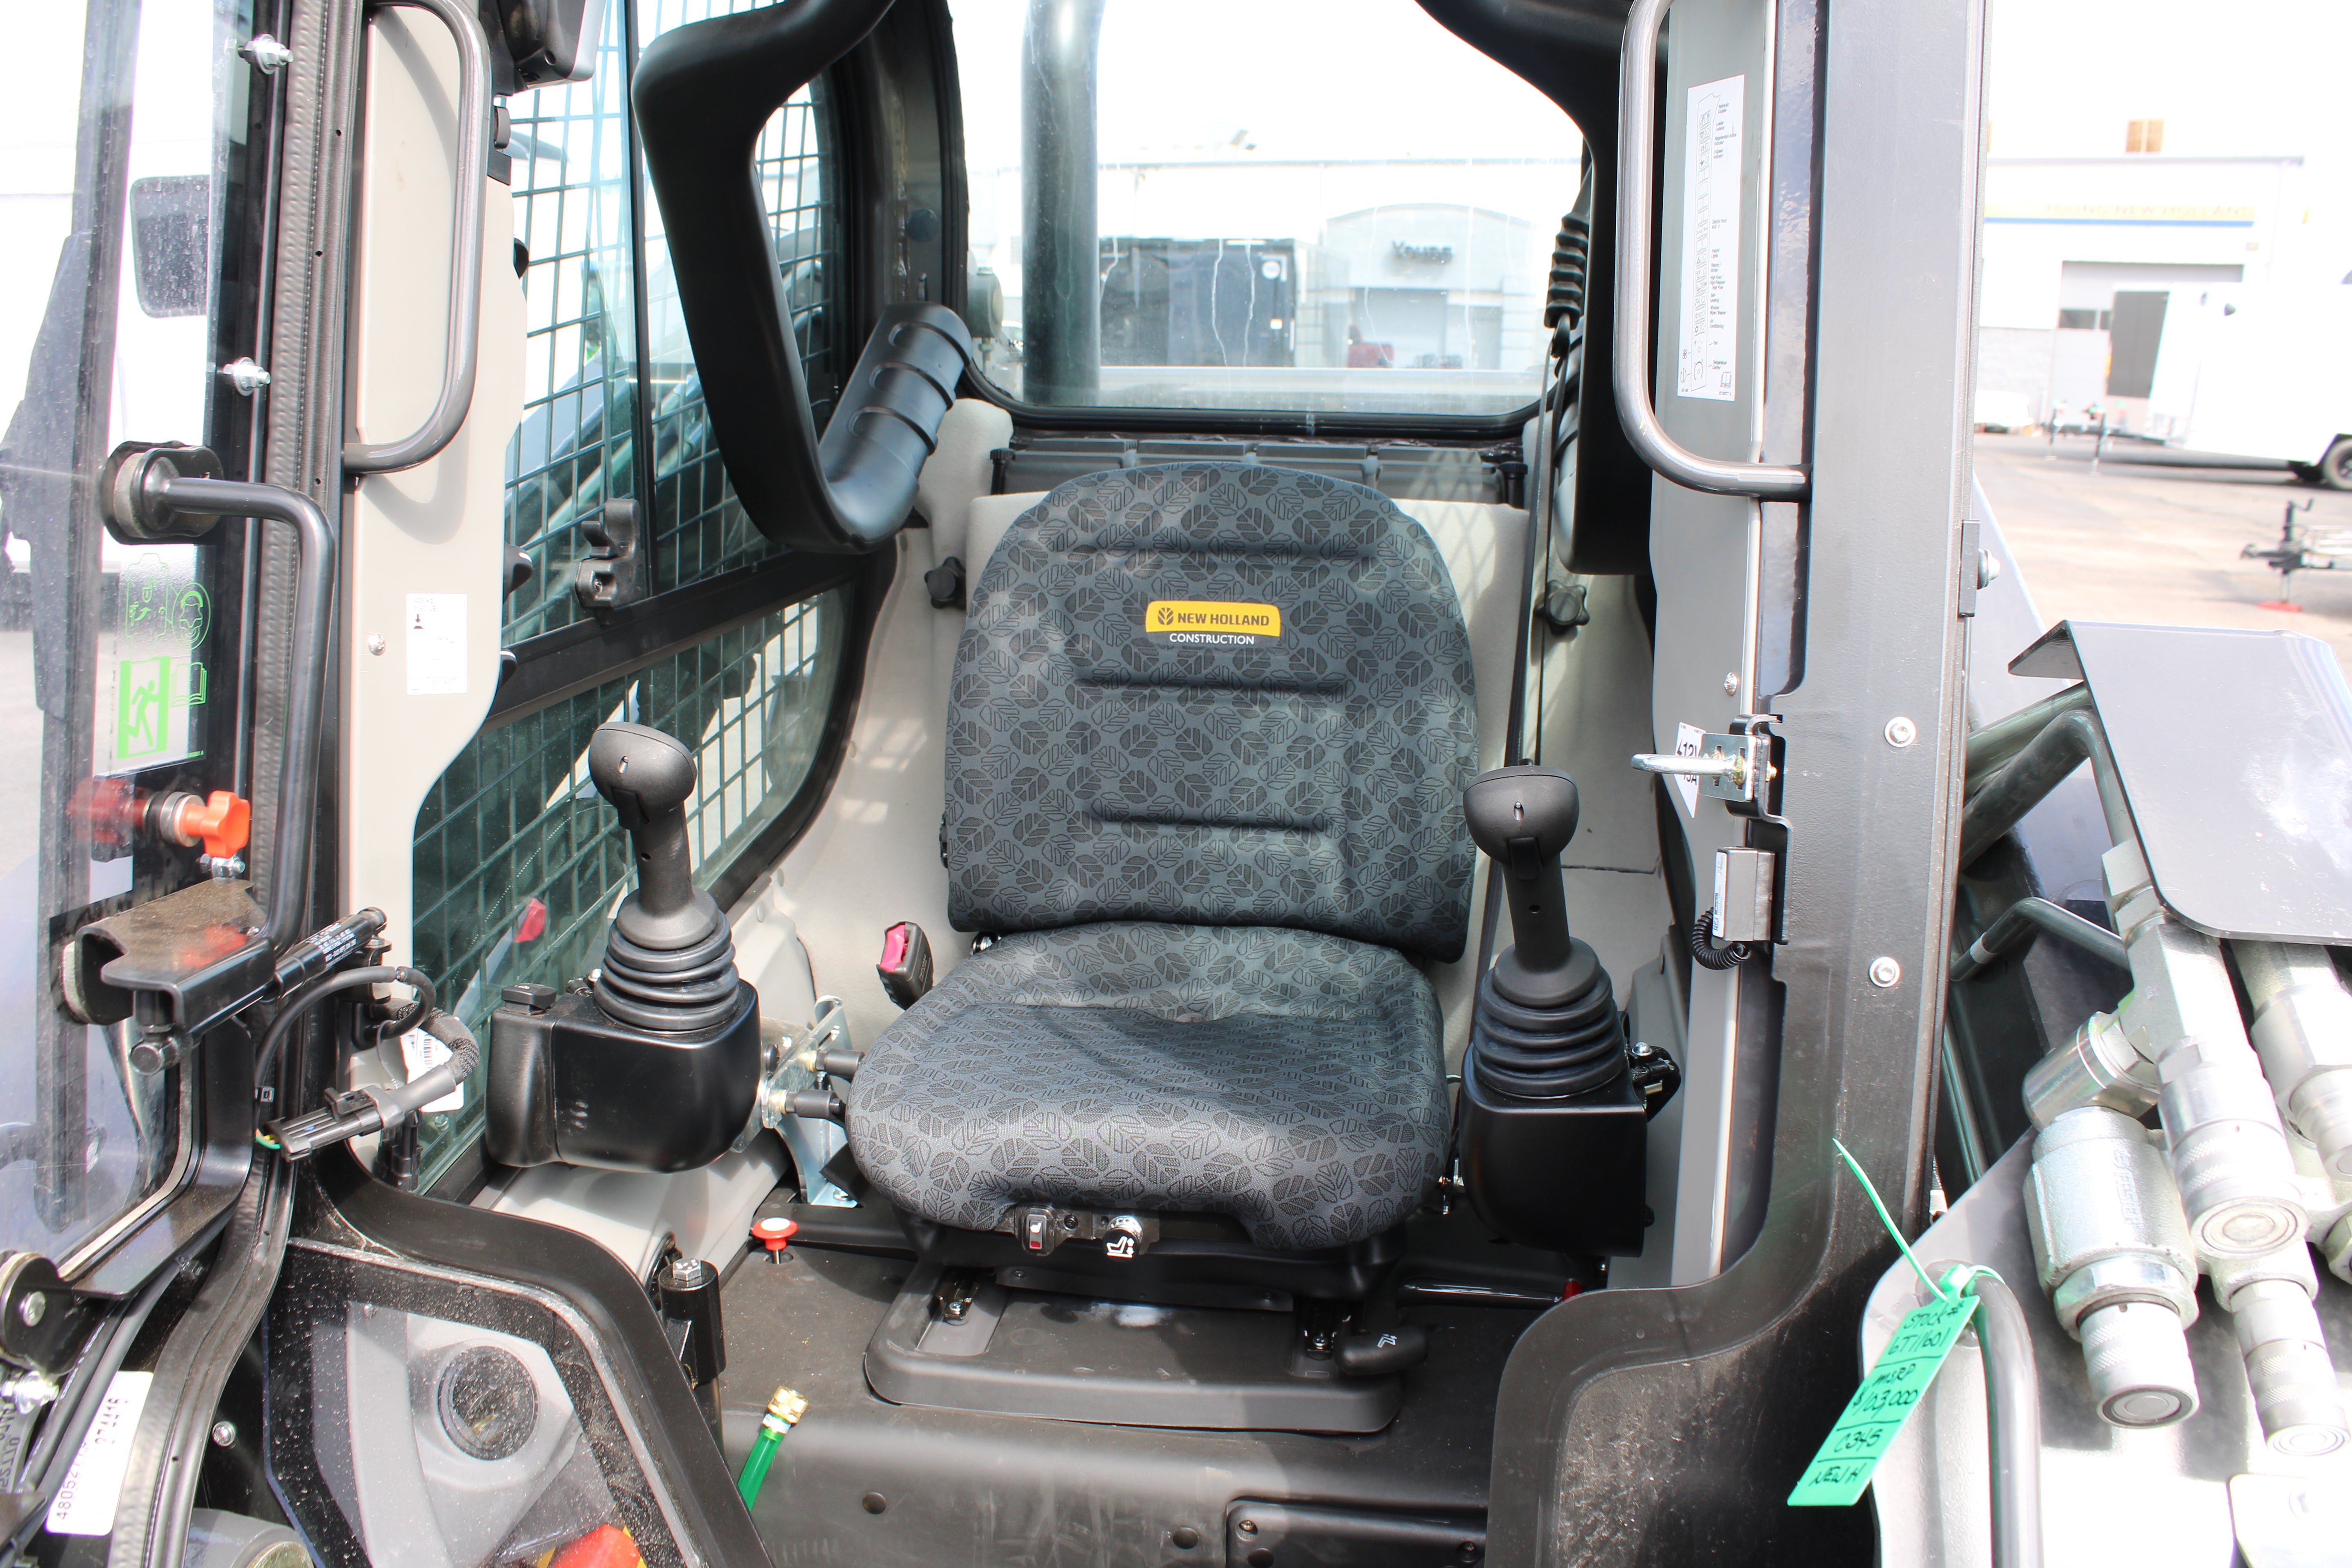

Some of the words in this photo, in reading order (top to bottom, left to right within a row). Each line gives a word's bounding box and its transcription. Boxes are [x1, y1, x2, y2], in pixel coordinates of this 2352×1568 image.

[1178, 612, 1207, 624] NEW
[1210, 614, 1270, 626] HOLLAND
[1169, 633, 1254, 645] CONSTRUCTION
